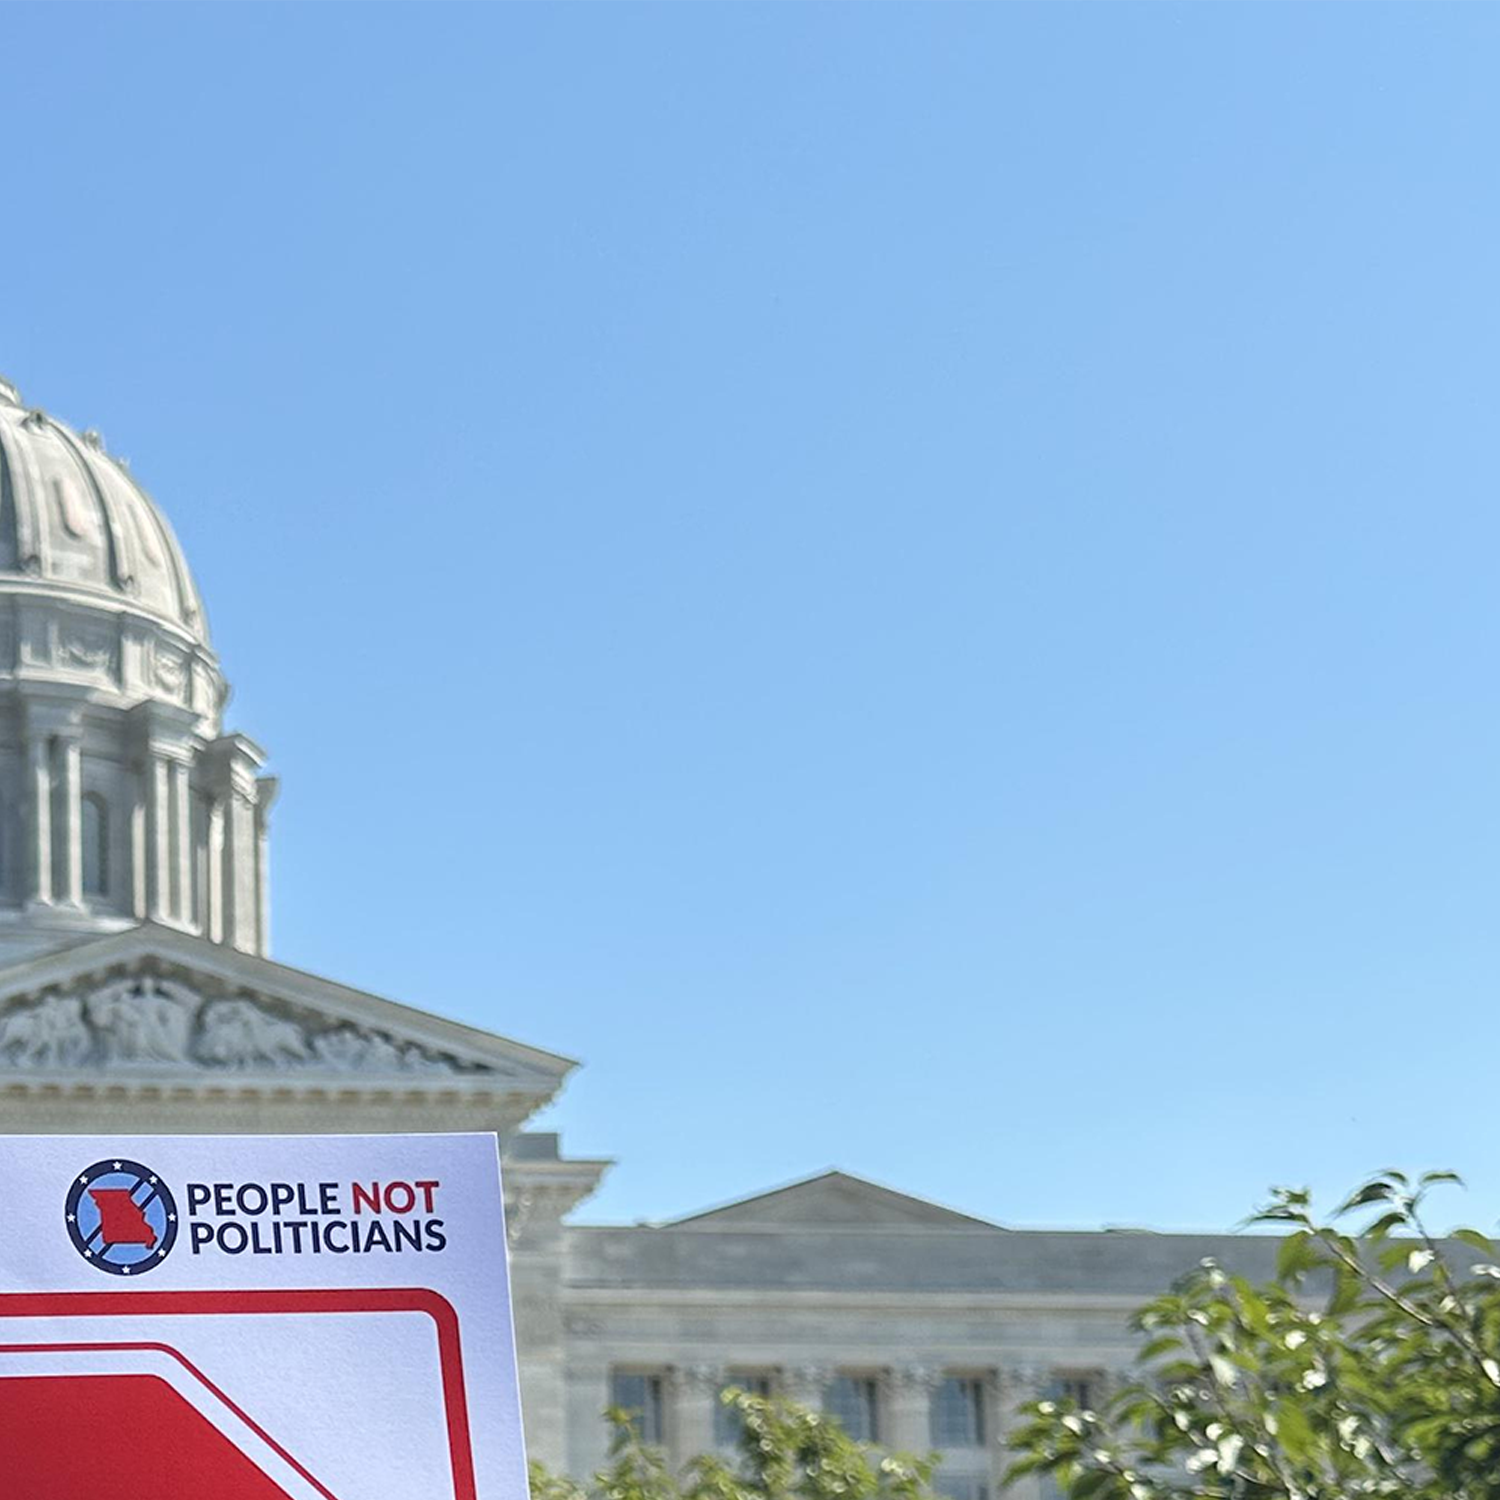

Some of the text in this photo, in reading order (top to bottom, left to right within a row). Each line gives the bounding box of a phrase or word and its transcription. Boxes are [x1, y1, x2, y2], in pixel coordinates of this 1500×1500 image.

[187, 1180, 440, 1216] PEOPLE NOT
[190, 1218, 447, 1255] POLITICIANS
